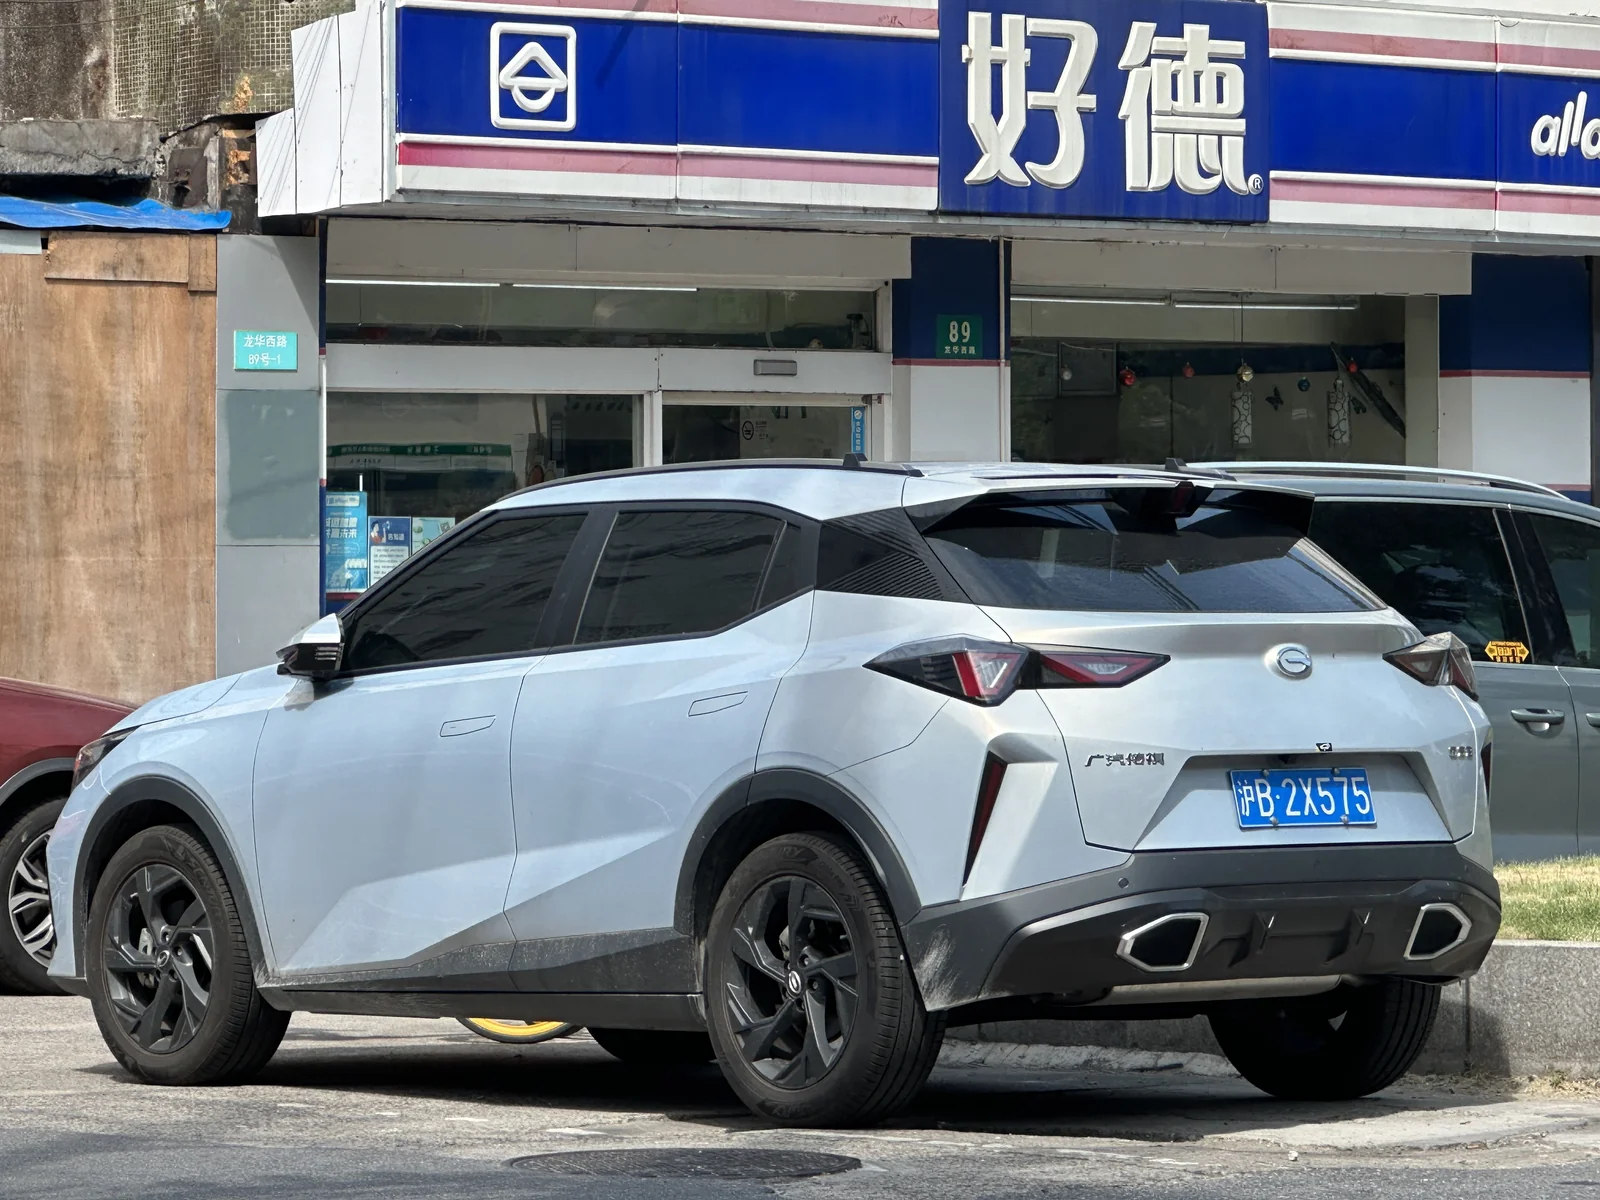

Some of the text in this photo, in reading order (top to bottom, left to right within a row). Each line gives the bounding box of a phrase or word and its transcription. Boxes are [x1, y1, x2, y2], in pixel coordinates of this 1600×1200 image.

[961, 11, 1249, 195] 好德
[243, 334, 288, 348] 龙华西路
[949, 320, 970, 343] 89
[248, 352, 281, 367] 89号-1
[1237, 777, 1371, 818] 沪B·2X575
